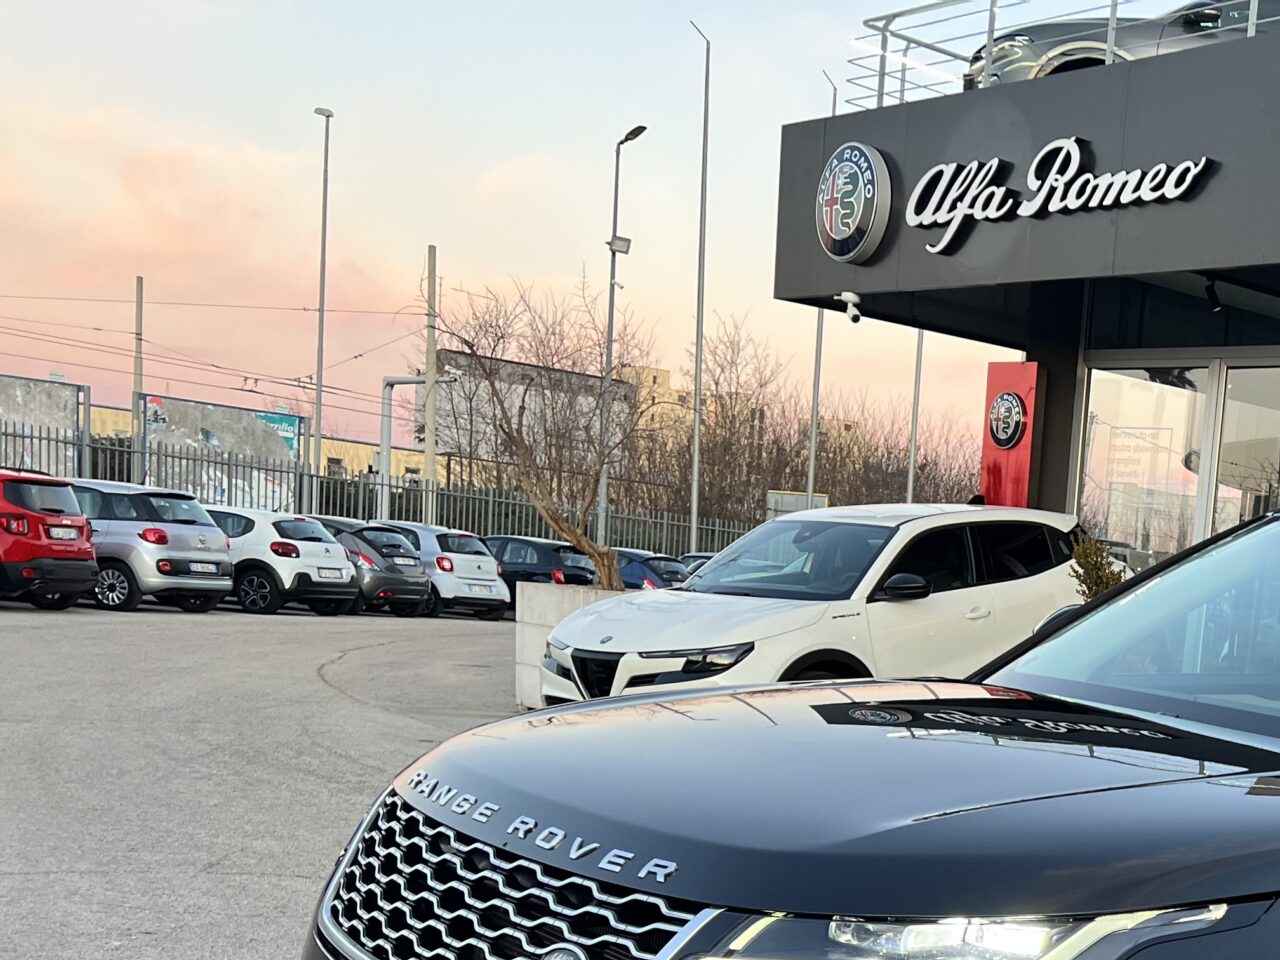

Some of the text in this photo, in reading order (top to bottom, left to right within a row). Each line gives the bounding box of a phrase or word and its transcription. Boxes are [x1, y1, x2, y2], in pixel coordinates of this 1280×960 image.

[818, 149, 873, 205] ALFA ROMEO
[904, 136, 1207, 254] Alfa Romeo
[406, 768, 679, 884] RANGE ROVER
